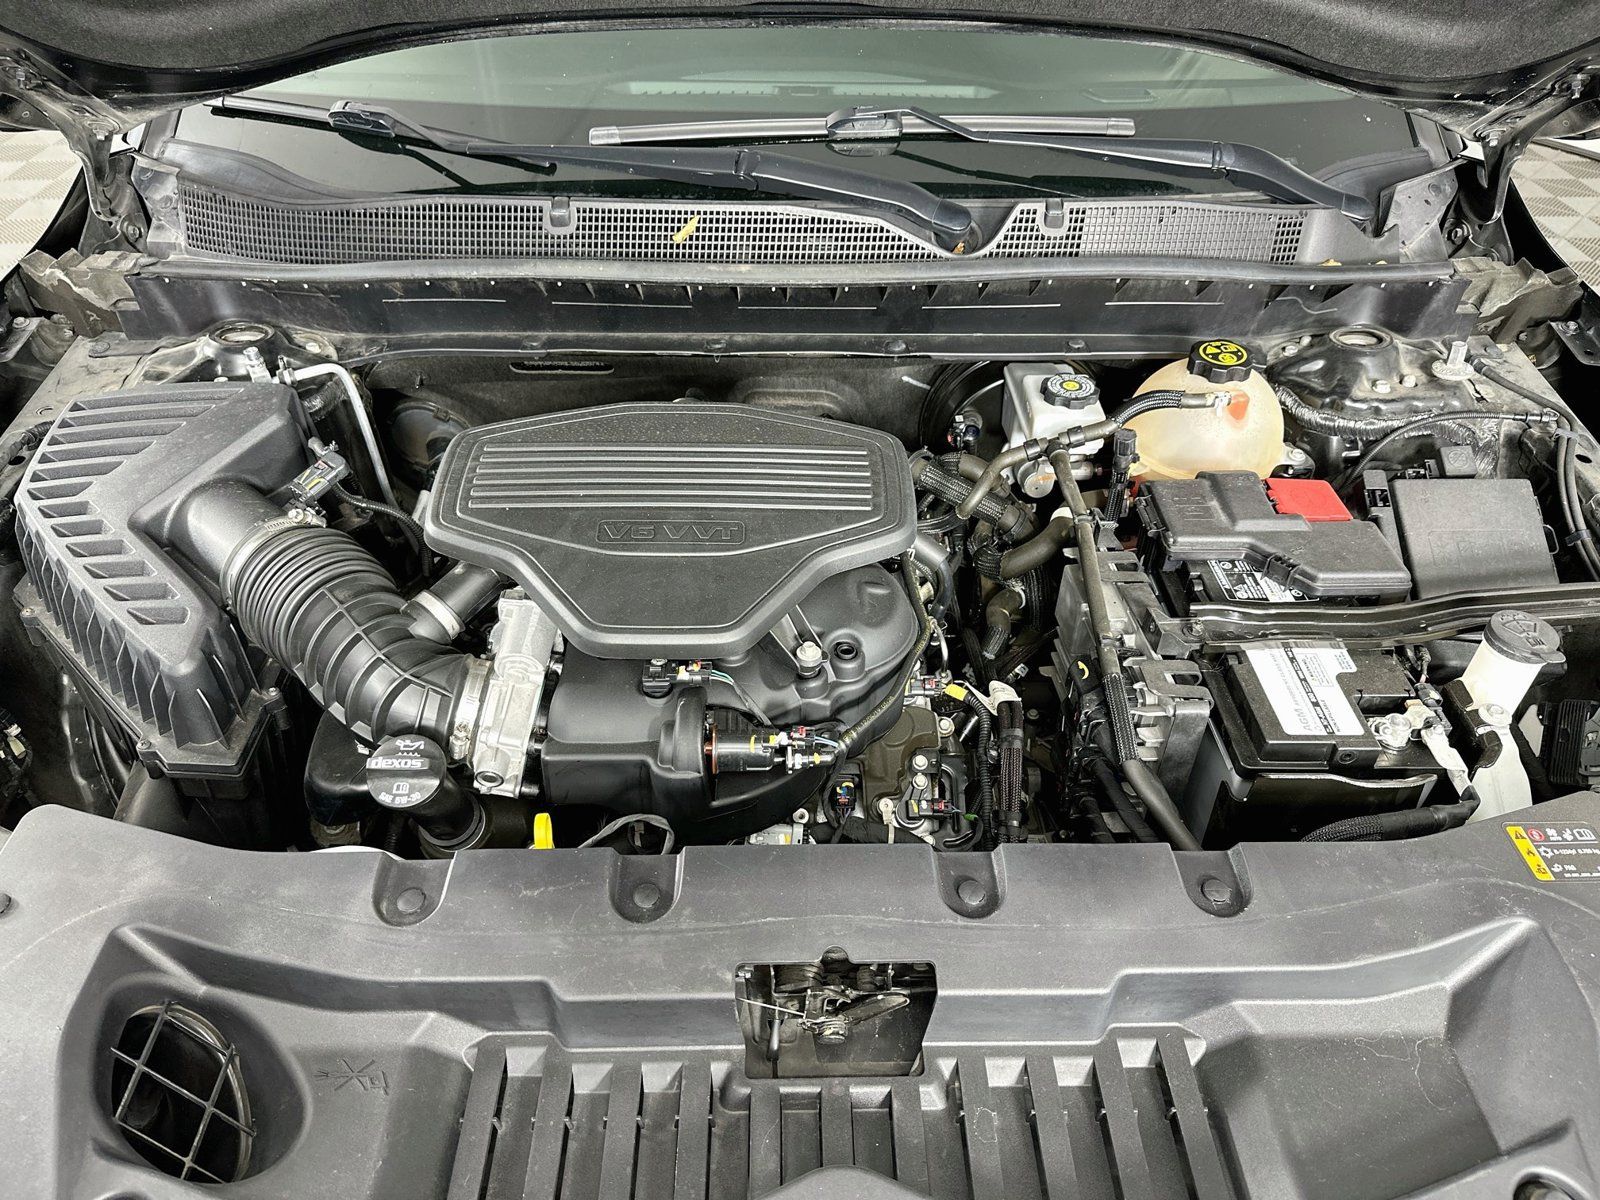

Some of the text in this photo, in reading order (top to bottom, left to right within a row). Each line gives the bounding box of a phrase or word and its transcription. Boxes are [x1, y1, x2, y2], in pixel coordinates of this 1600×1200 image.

[603, 524, 739, 540] V6 VVT
[370, 756, 424, 769] dexos
